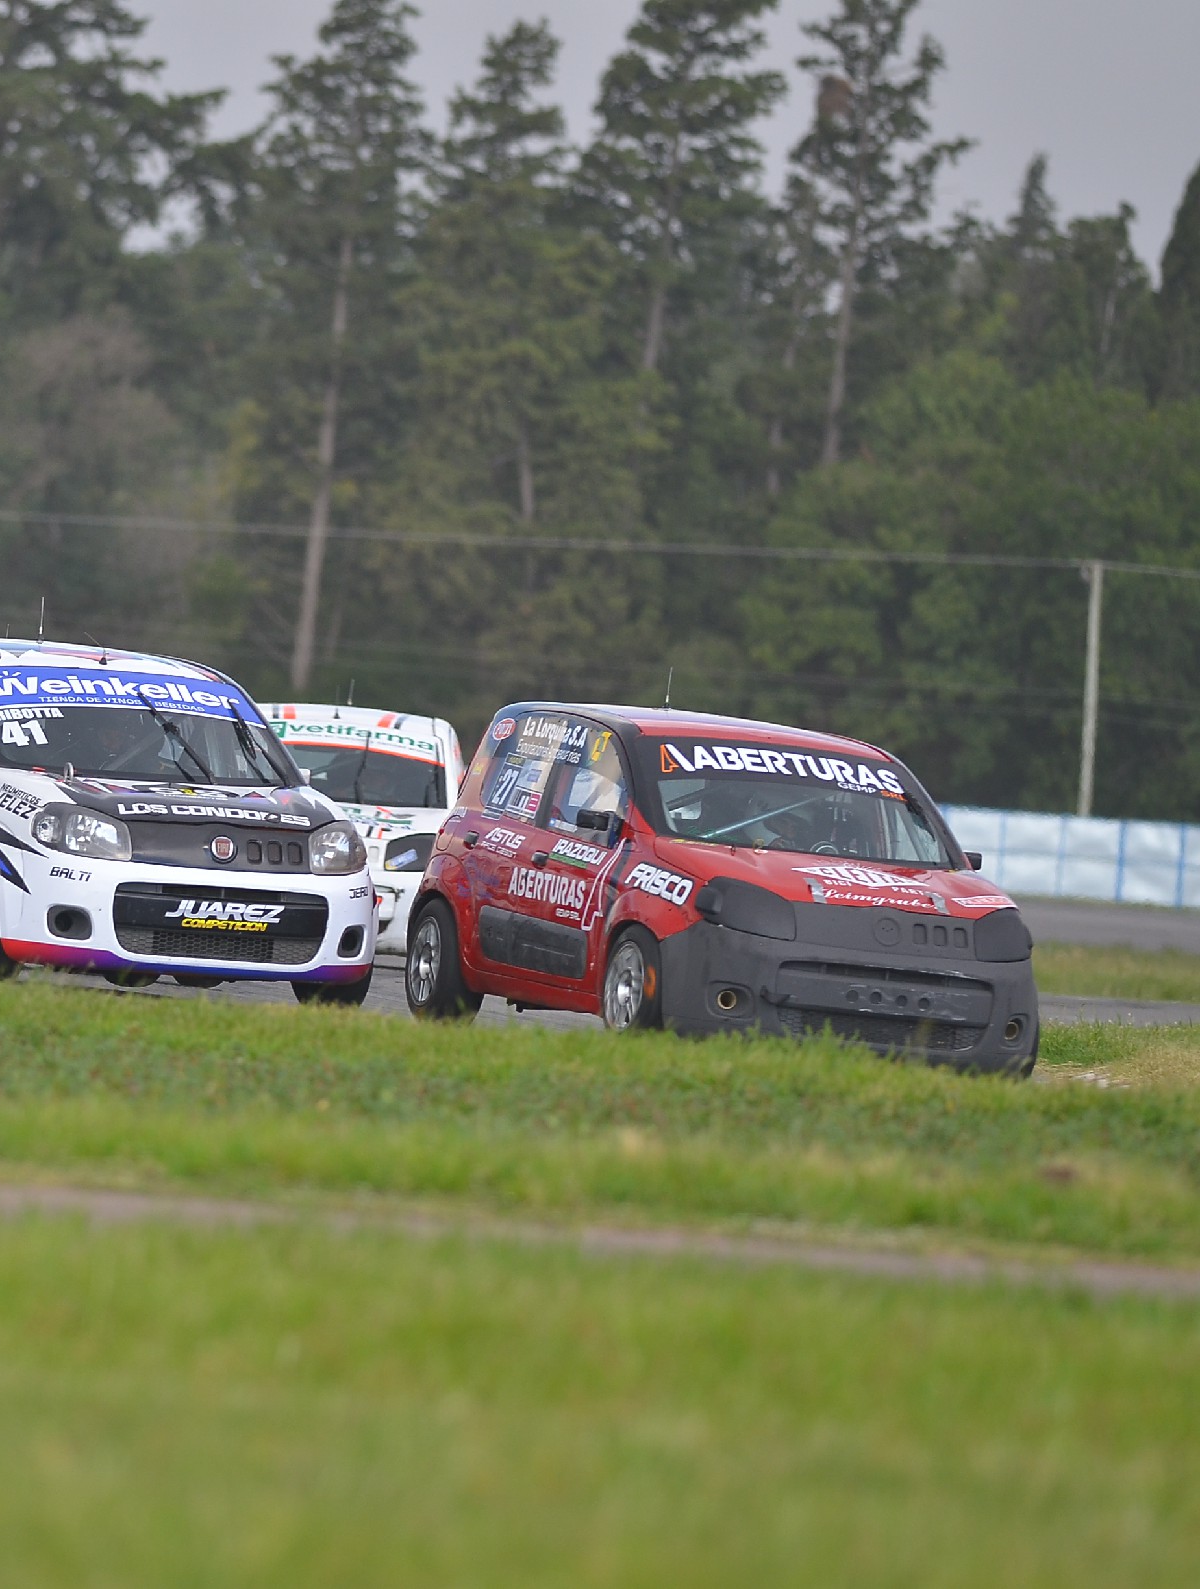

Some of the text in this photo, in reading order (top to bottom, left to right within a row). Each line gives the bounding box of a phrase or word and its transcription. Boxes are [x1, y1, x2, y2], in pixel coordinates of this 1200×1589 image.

[103, 697, 142, 705] VINOS
[154, 701, 205, 712] BEBIDAS
[2, 719, 48, 747] 41
[289, 723, 435, 751] vetifarma
[693, 745, 905, 795] ABERTURAS
[118, 803, 168, 815] LOS
[624, 862, 695, 906] FRISCO
[164, 899, 286, 923] JUAREZ
[181, 917, 269, 932] COMPETICION
